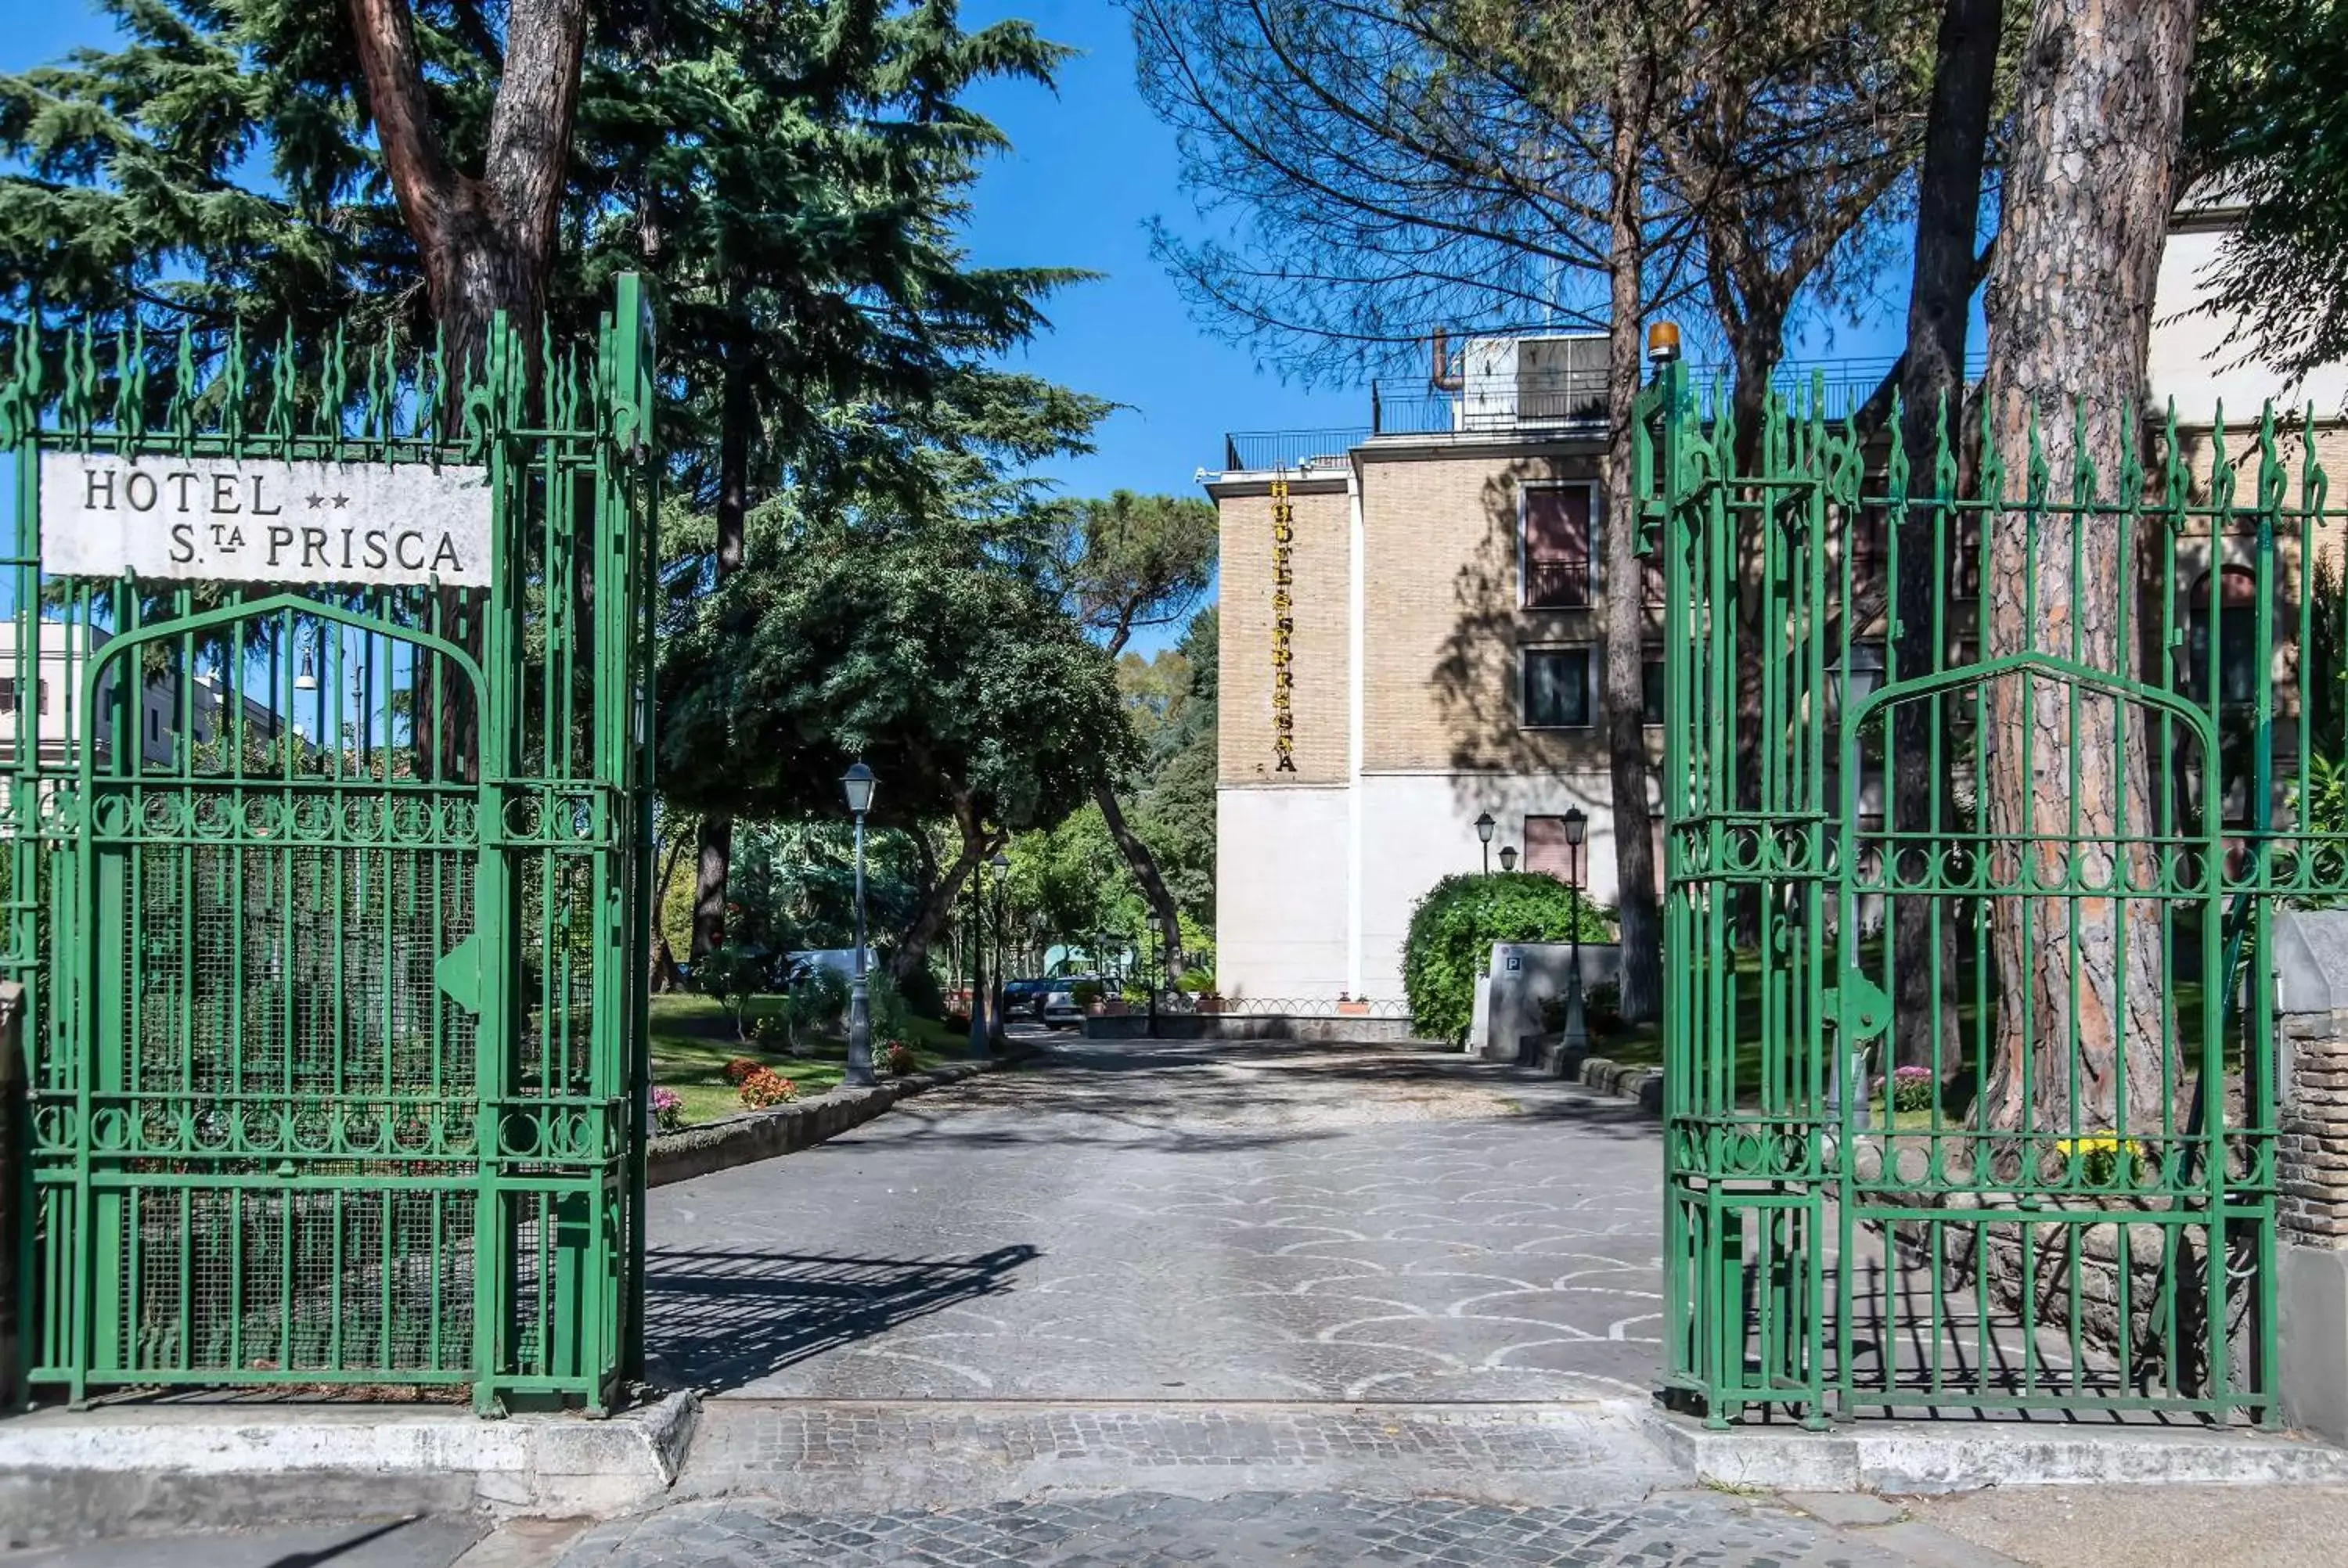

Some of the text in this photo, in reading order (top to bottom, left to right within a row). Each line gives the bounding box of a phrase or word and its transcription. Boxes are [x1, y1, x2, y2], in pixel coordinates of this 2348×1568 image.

[85, 469, 283, 515] HOTEL
[266, 525, 464, 572] PRISCA
[1508, 958, 1518, 969] P
